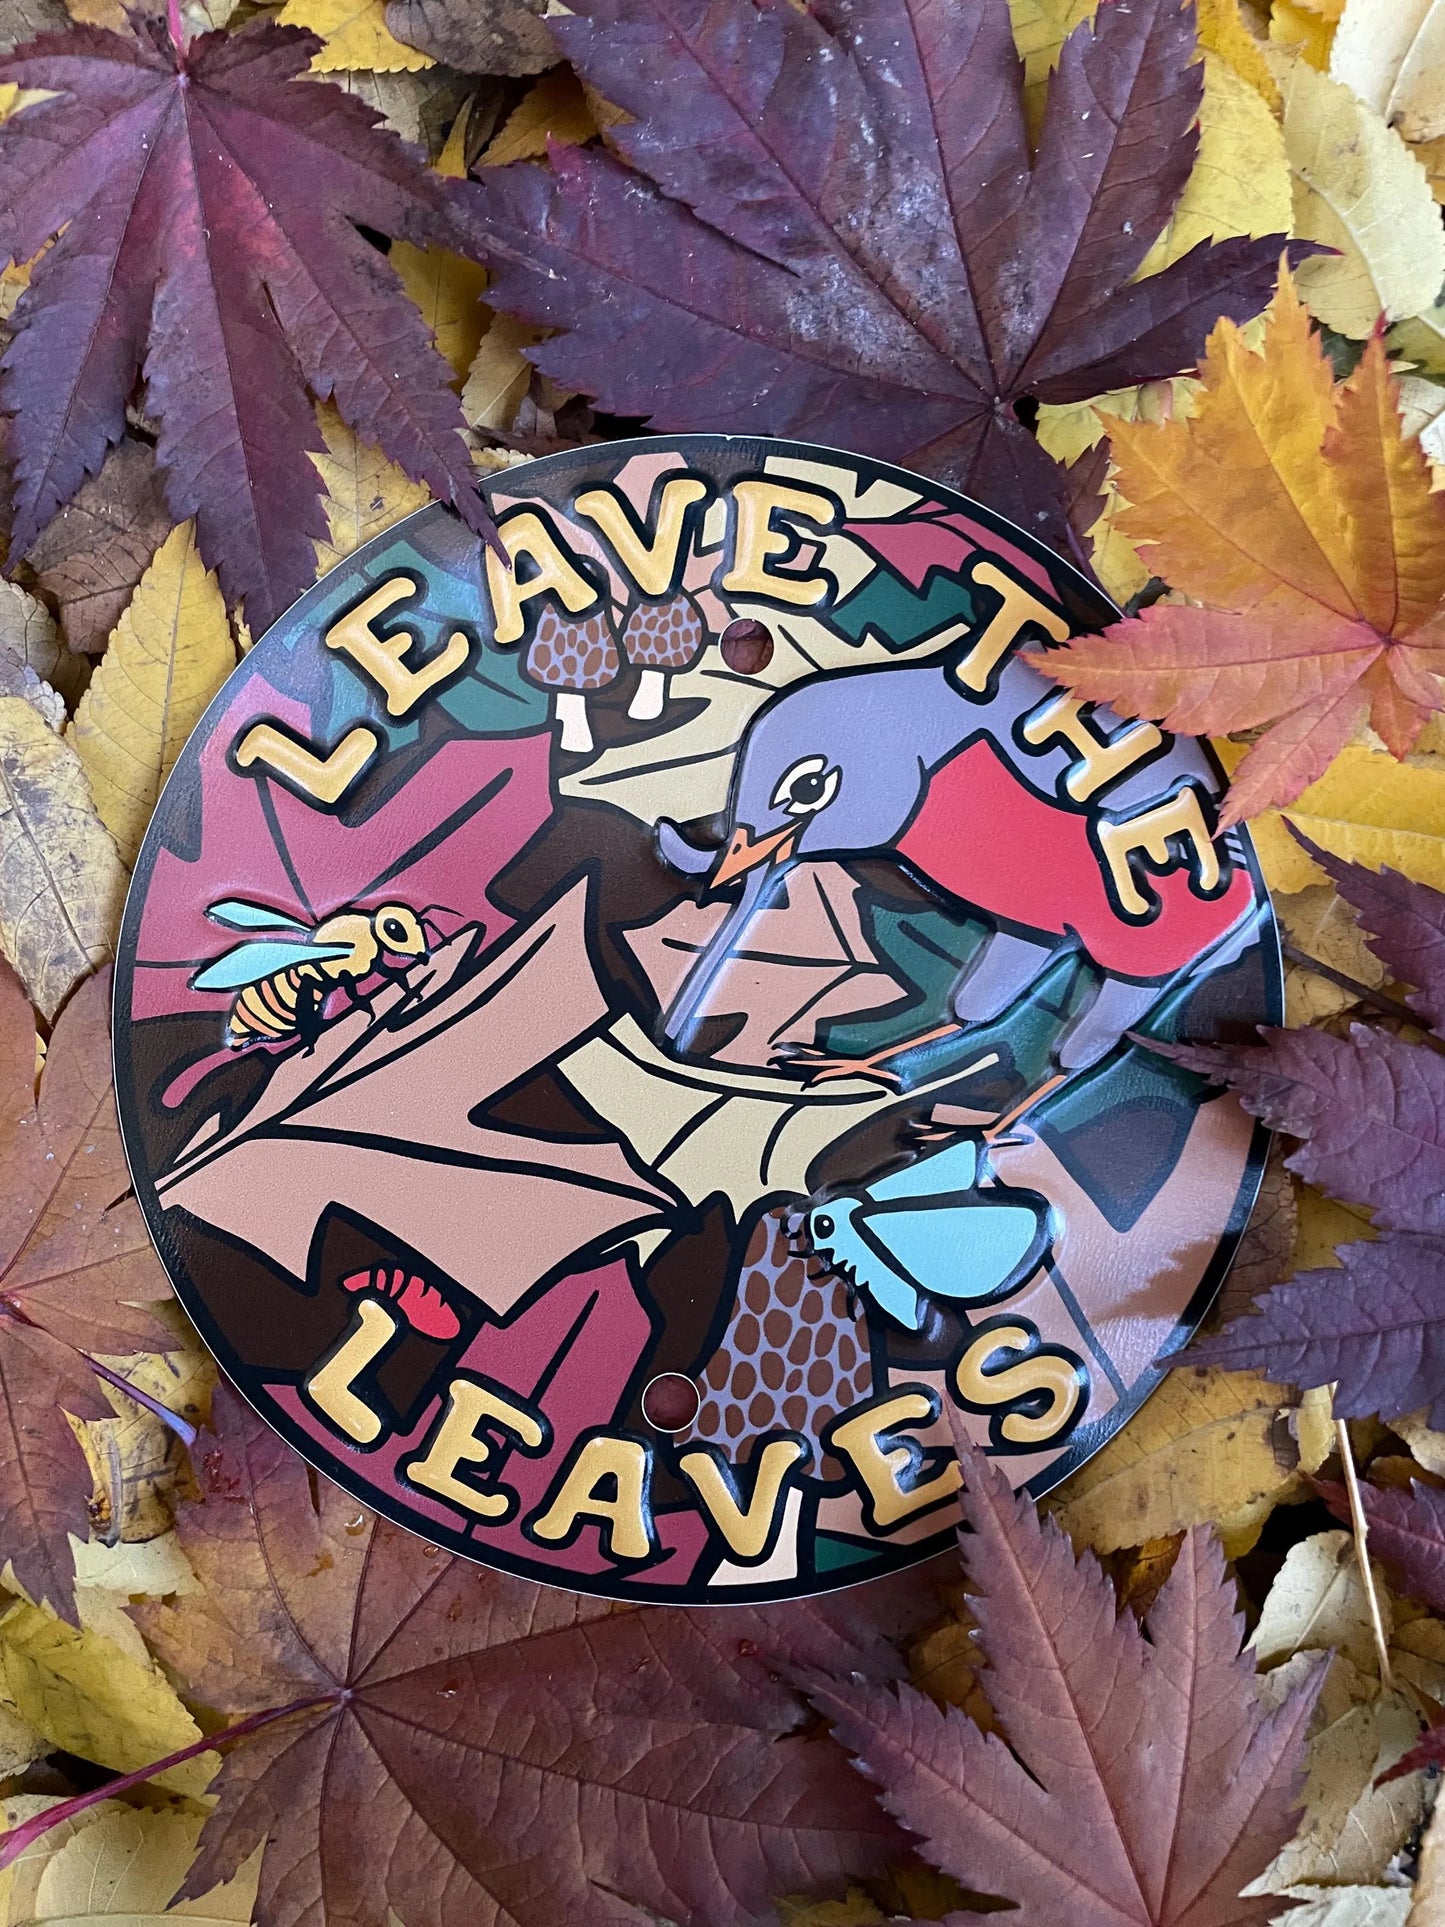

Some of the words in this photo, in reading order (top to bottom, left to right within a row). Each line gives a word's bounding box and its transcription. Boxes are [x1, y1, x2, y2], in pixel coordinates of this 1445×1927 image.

[236, 478, 837, 804] LEAVE
[956, 560, 1219, 915] THE
[307, 1298, 1081, 1559] LEAVES
